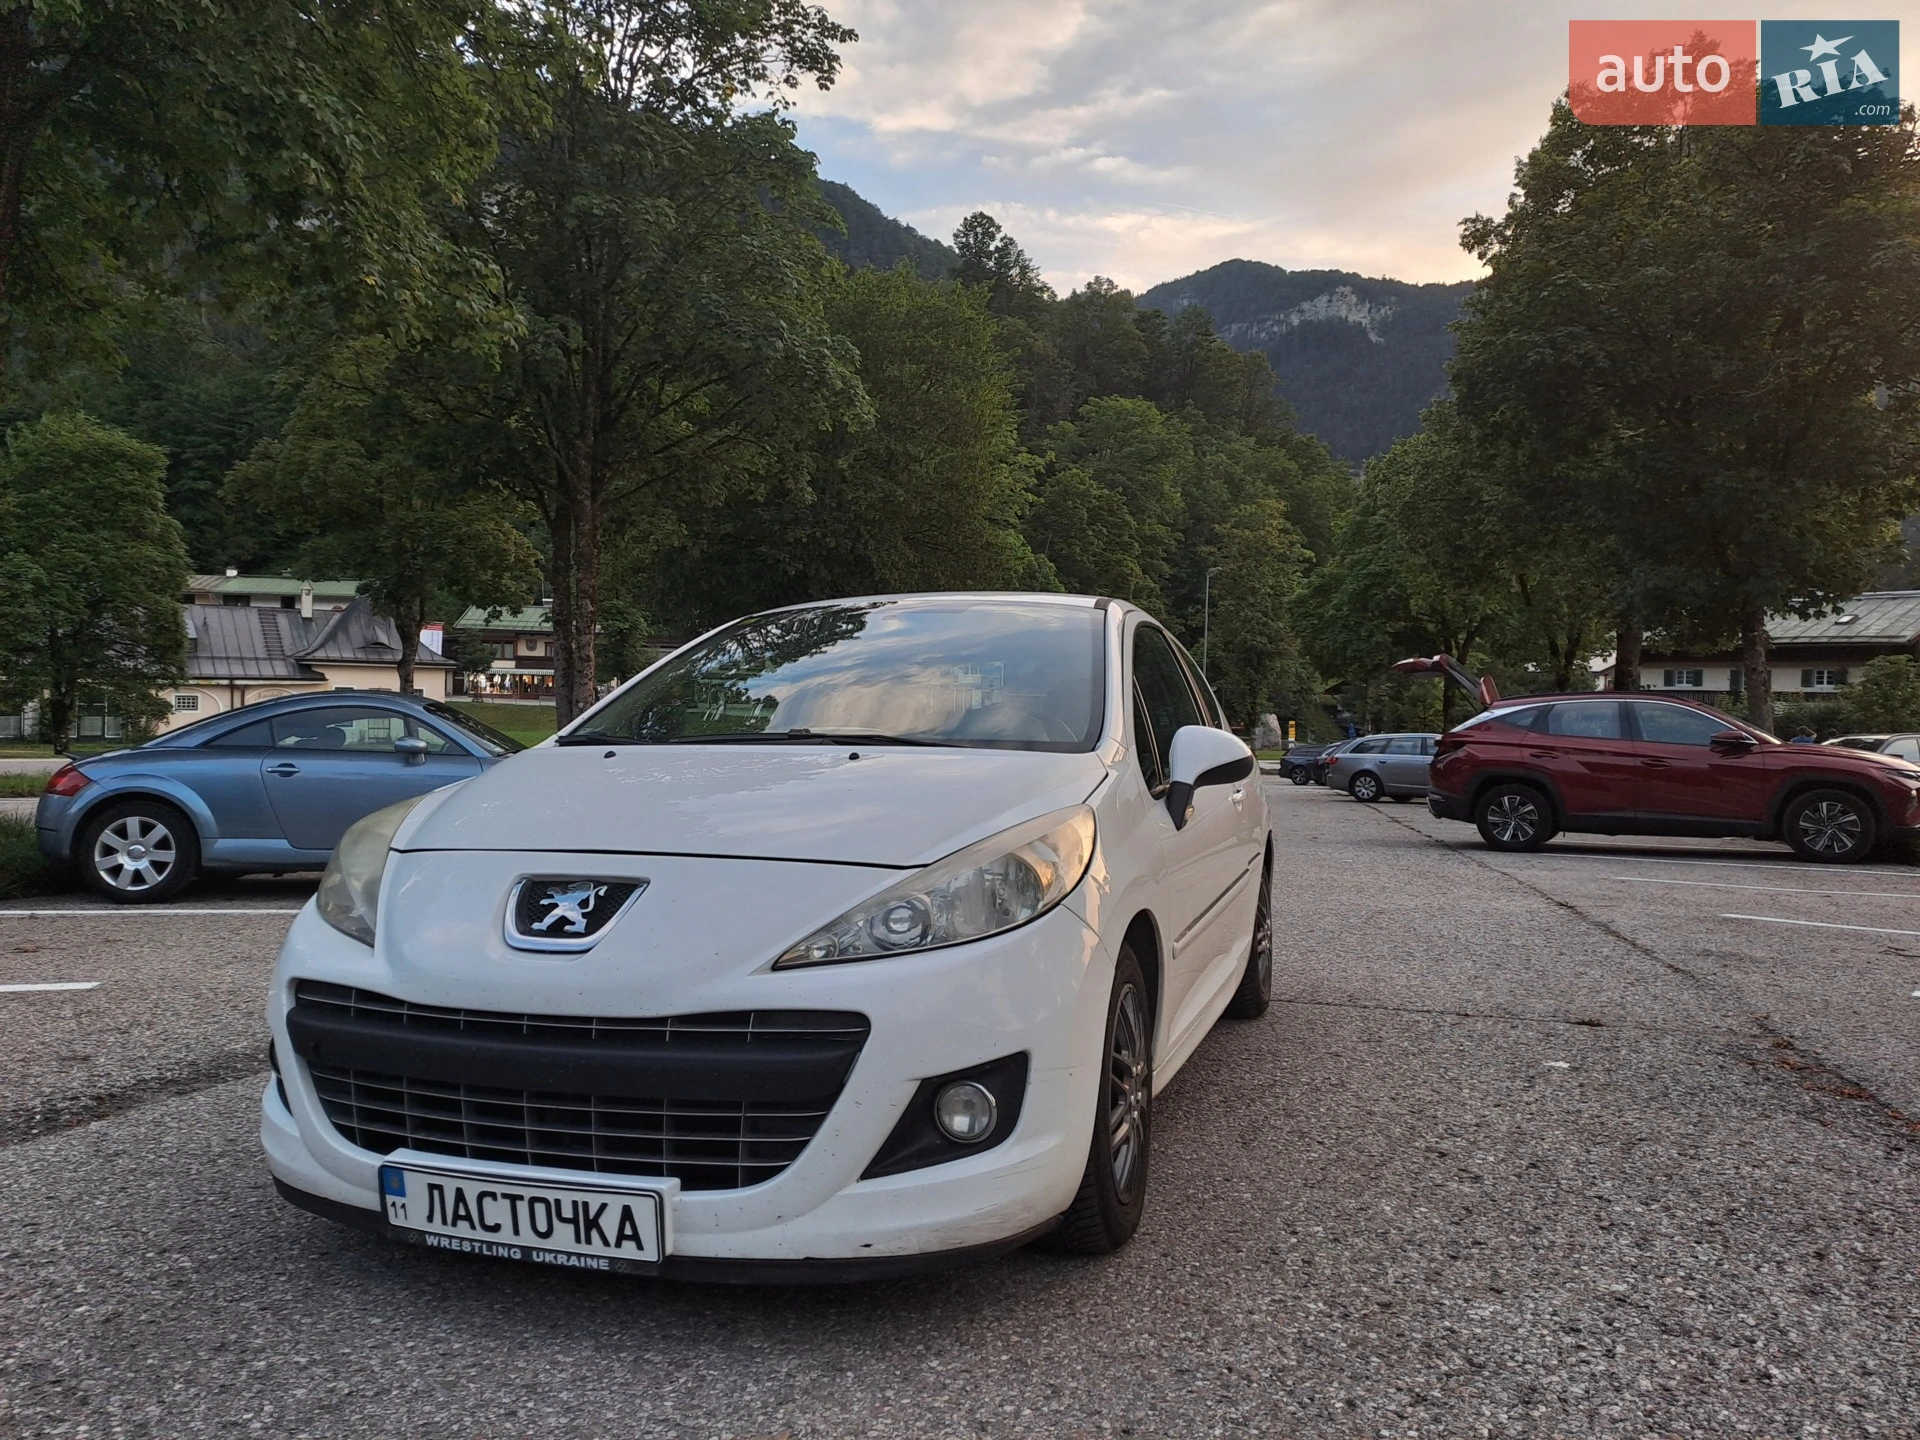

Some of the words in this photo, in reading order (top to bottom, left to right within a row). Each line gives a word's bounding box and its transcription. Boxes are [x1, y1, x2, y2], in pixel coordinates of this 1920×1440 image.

[390, 1200, 408, 1221] 11
[426, 1182, 645, 1252] ЛАСТОЧКА
[425, 1234, 522, 1260] WRESTLING
[532, 1250, 610, 1270] UKRAINE
